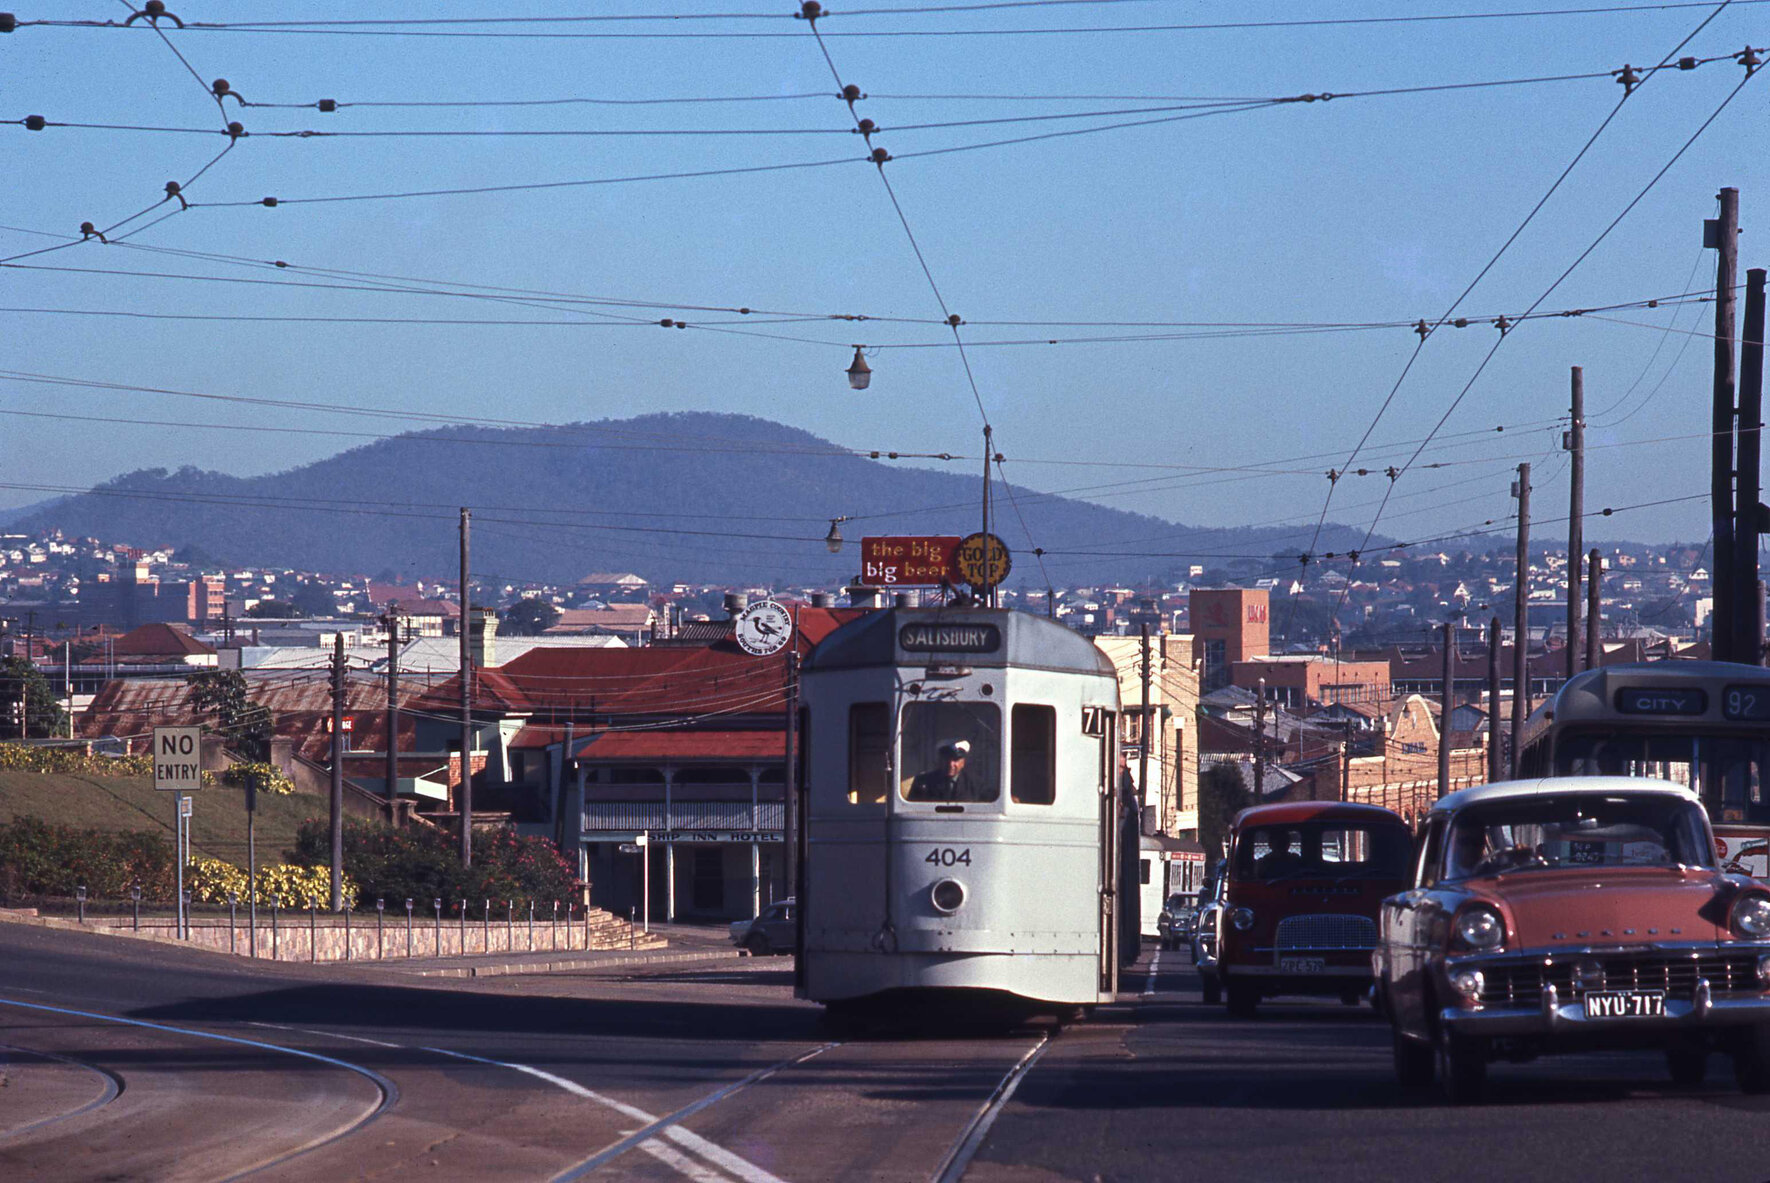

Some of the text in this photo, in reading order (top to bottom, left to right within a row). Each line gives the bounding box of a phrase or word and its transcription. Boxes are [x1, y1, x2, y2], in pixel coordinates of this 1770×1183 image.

[871, 541, 942, 562] the big
[867, 561, 950, 583] big beer
[905, 630, 989, 647] SALISBURY
[1636, 691, 1757, 717] CITY 92
[1083, 708, 1102, 733] 71
[162, 734, 194, 756] NO
[157, 763, 198, 780] ENTRY
[648, 832, 780, 842] SHIP INN HOTEL
[924, 847, 972, 867] 404
